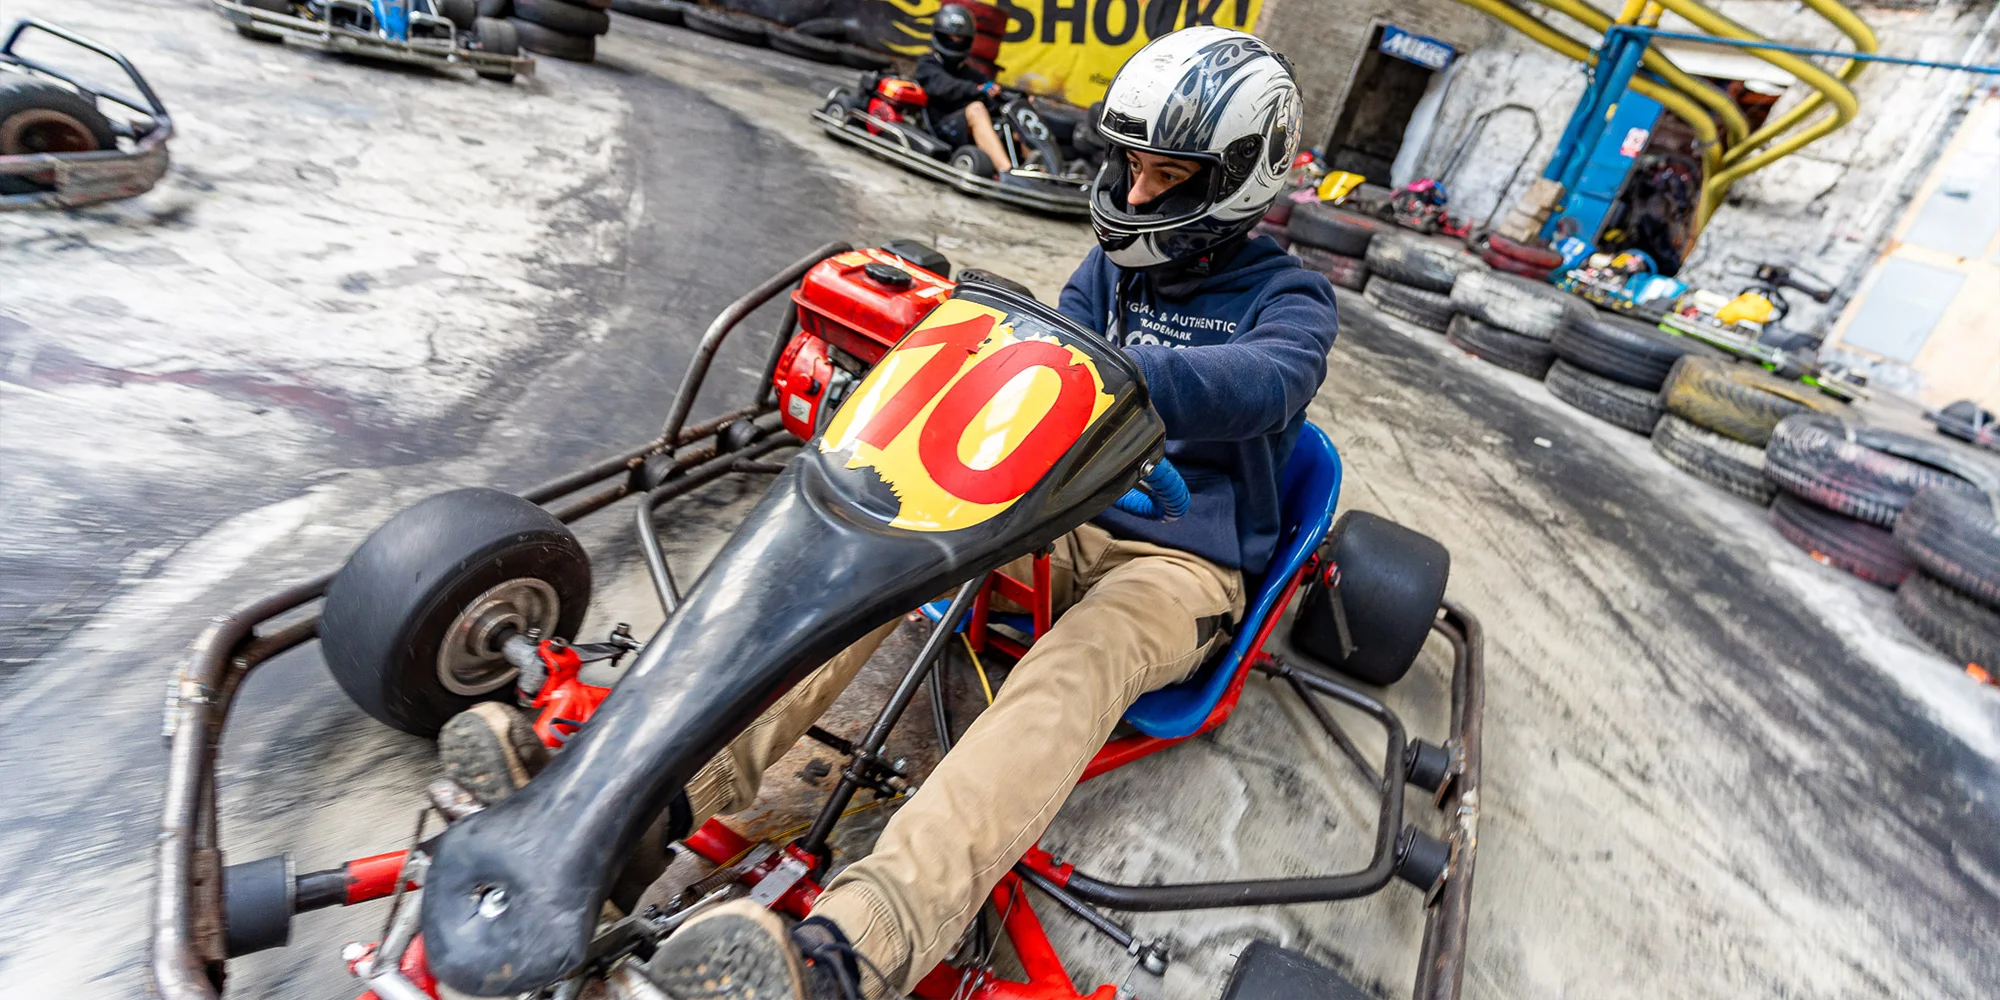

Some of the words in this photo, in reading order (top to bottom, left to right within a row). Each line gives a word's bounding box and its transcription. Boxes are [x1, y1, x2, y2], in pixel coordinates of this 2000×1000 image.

[1159, 312, 1168, 322] &
[1171, 313, 1237, 333] AUTHENTIC
[855, 314, 1096, 504] 10
